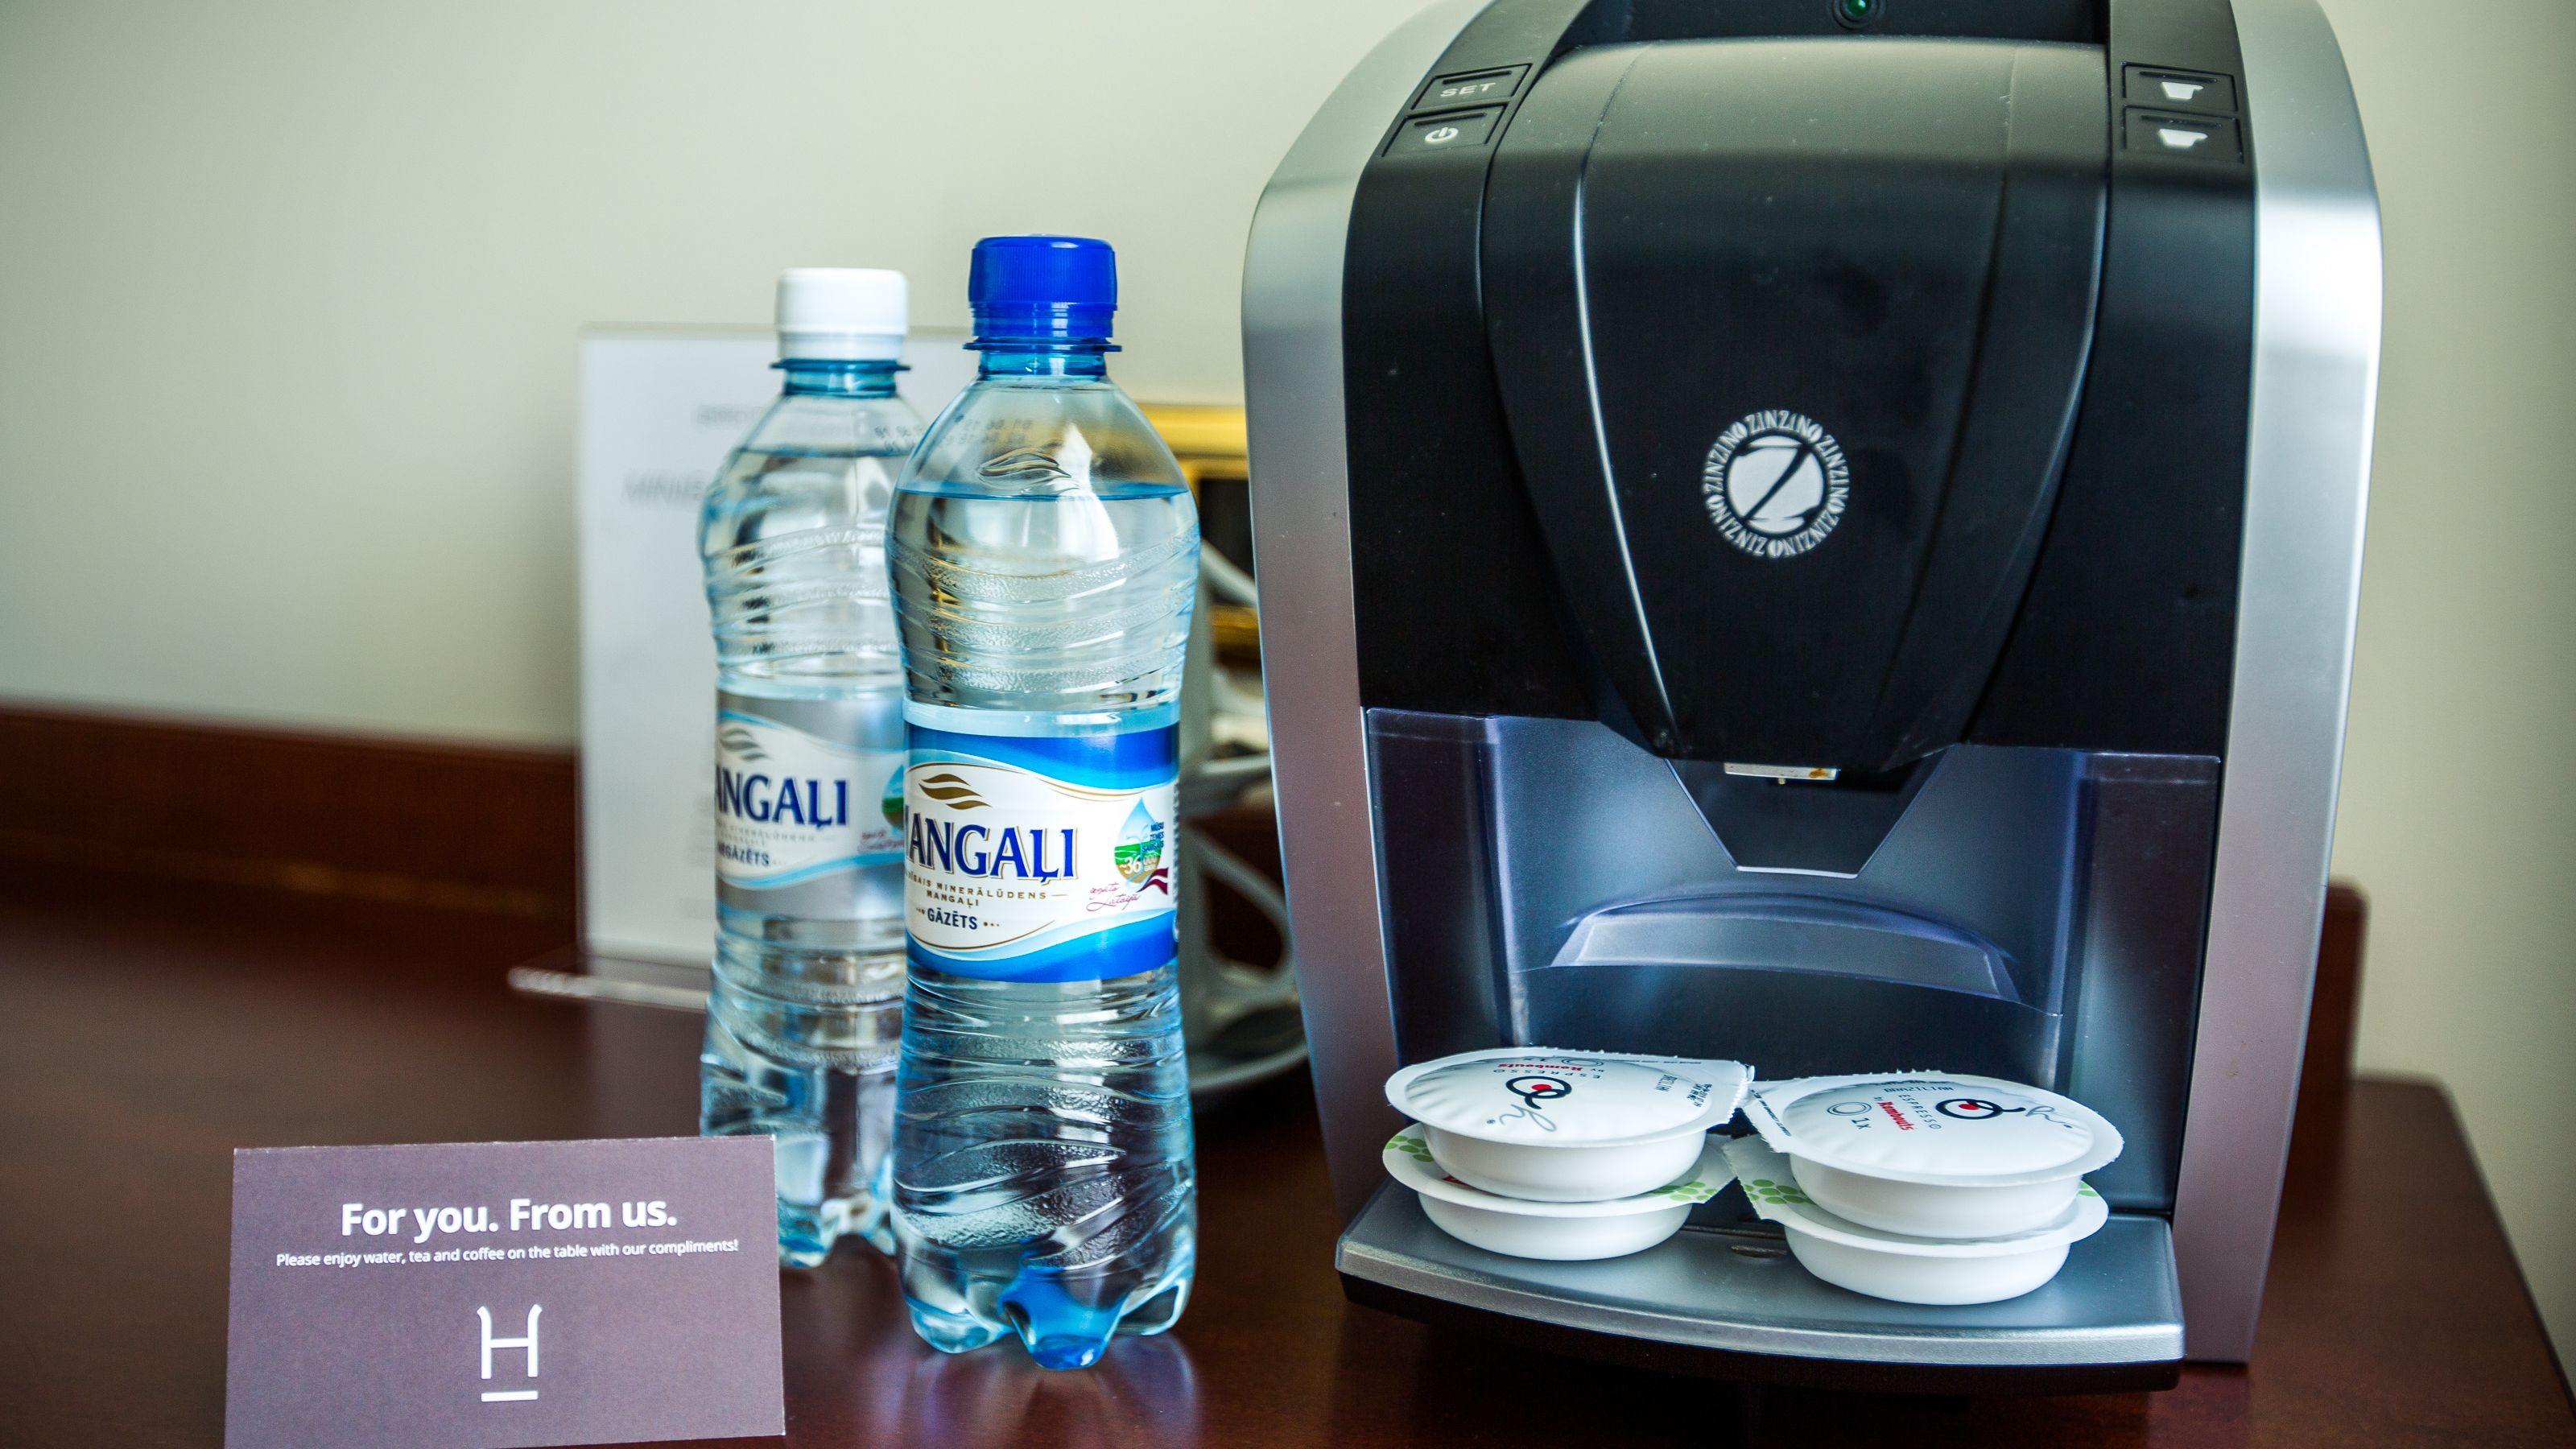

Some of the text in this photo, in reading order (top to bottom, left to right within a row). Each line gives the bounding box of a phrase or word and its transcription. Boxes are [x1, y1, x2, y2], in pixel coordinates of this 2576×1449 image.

[1439, 82, 1496, 97] SET
[715, 764, 848, 829] ANGAĻI
[905, 811, 1077, 885] ANGAĻI
[926, 889, 980, 909] MANGAĻI
[936, 882, 1046, 900] MINERĀLŪDENS
[927, 907, 978, 931] GĀZĒTS
[1492, 1068, 1602, 1080] ESPRESSO
[1497, 1063, 1585, 1072] Rombouts
[1851, 1117, 1872, 1130] 1x
[1876, 1101, 1915, 1132] Rombouts
[1897, 1094, 1942, 1130] ESPRESSO
[341, 1198, 678, 1244] For you. From us.
[276, 1238, 740, 1269] Please enjoy water, tea and coffee on the table with our compliments!
